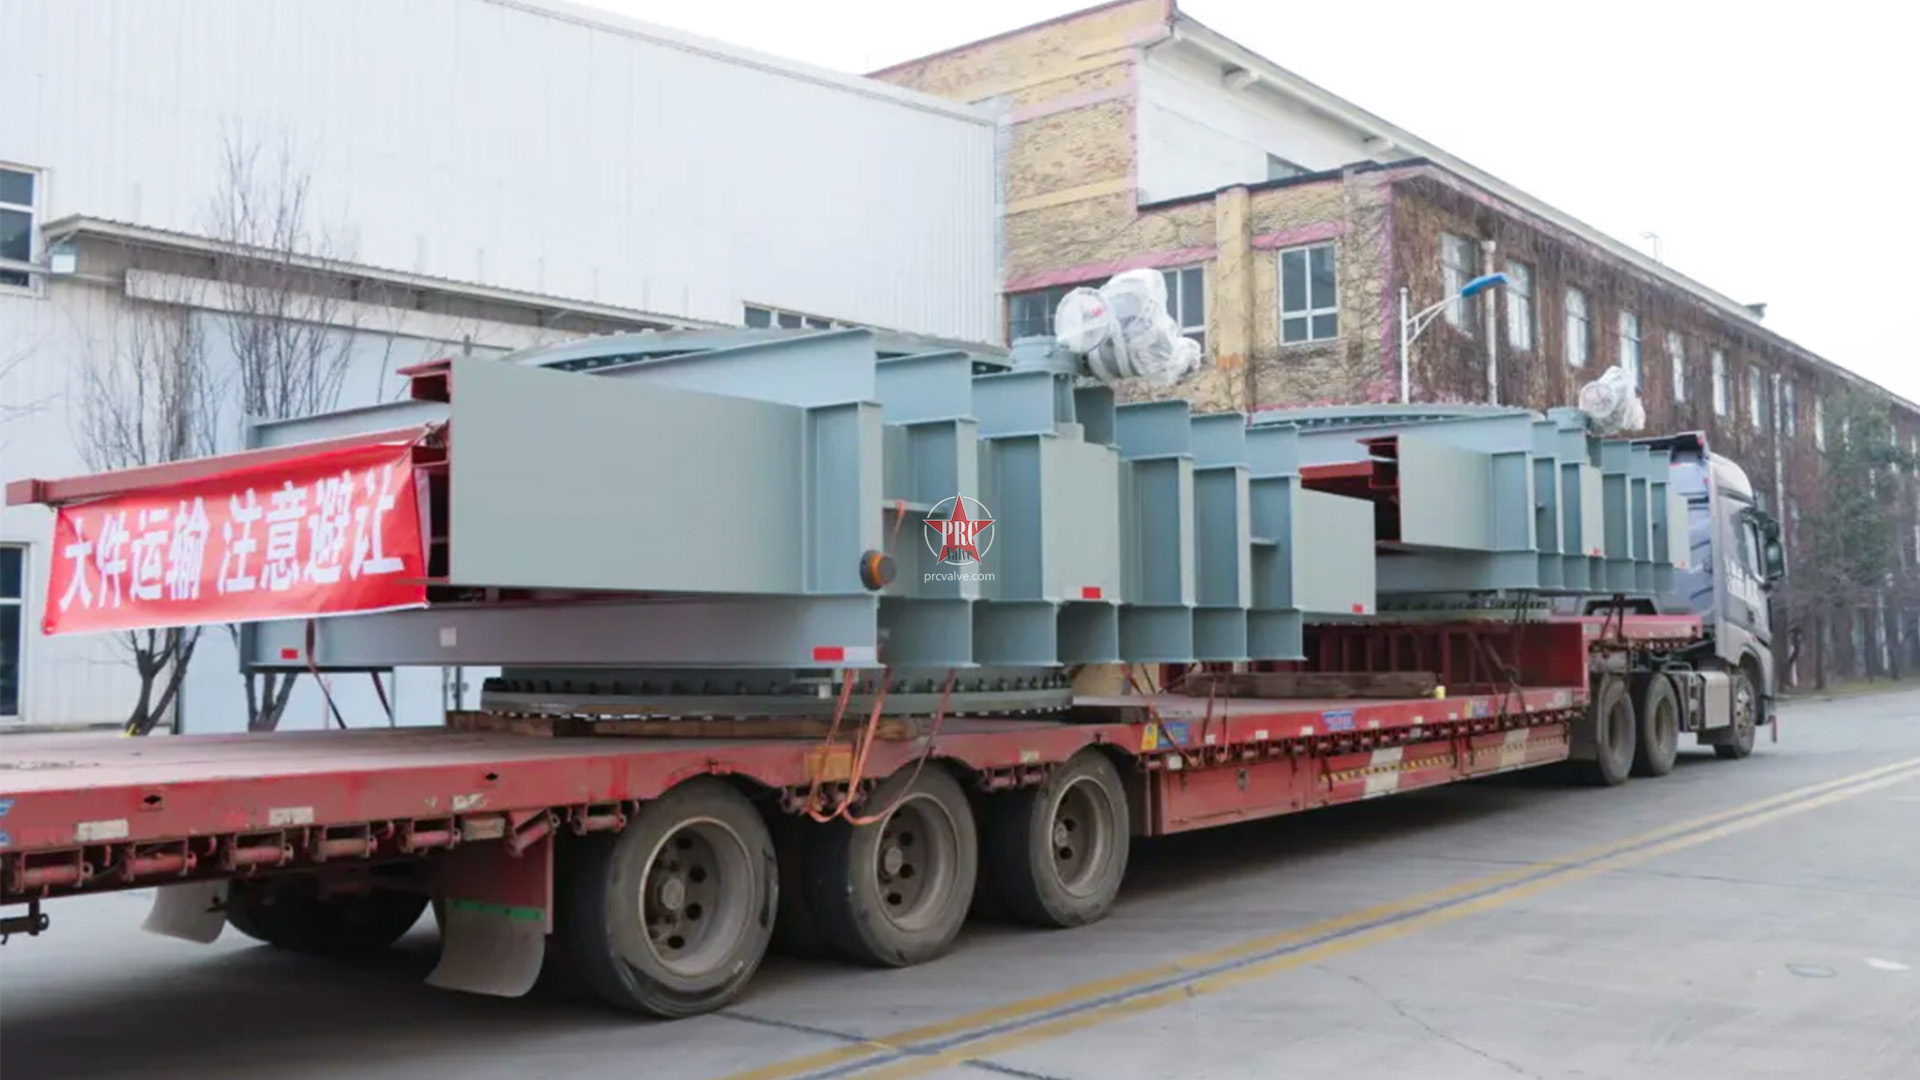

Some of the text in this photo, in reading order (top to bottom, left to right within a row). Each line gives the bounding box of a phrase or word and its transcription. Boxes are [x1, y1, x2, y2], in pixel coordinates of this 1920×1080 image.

[58, 464, 405, 612] 大件运输 注意避让
